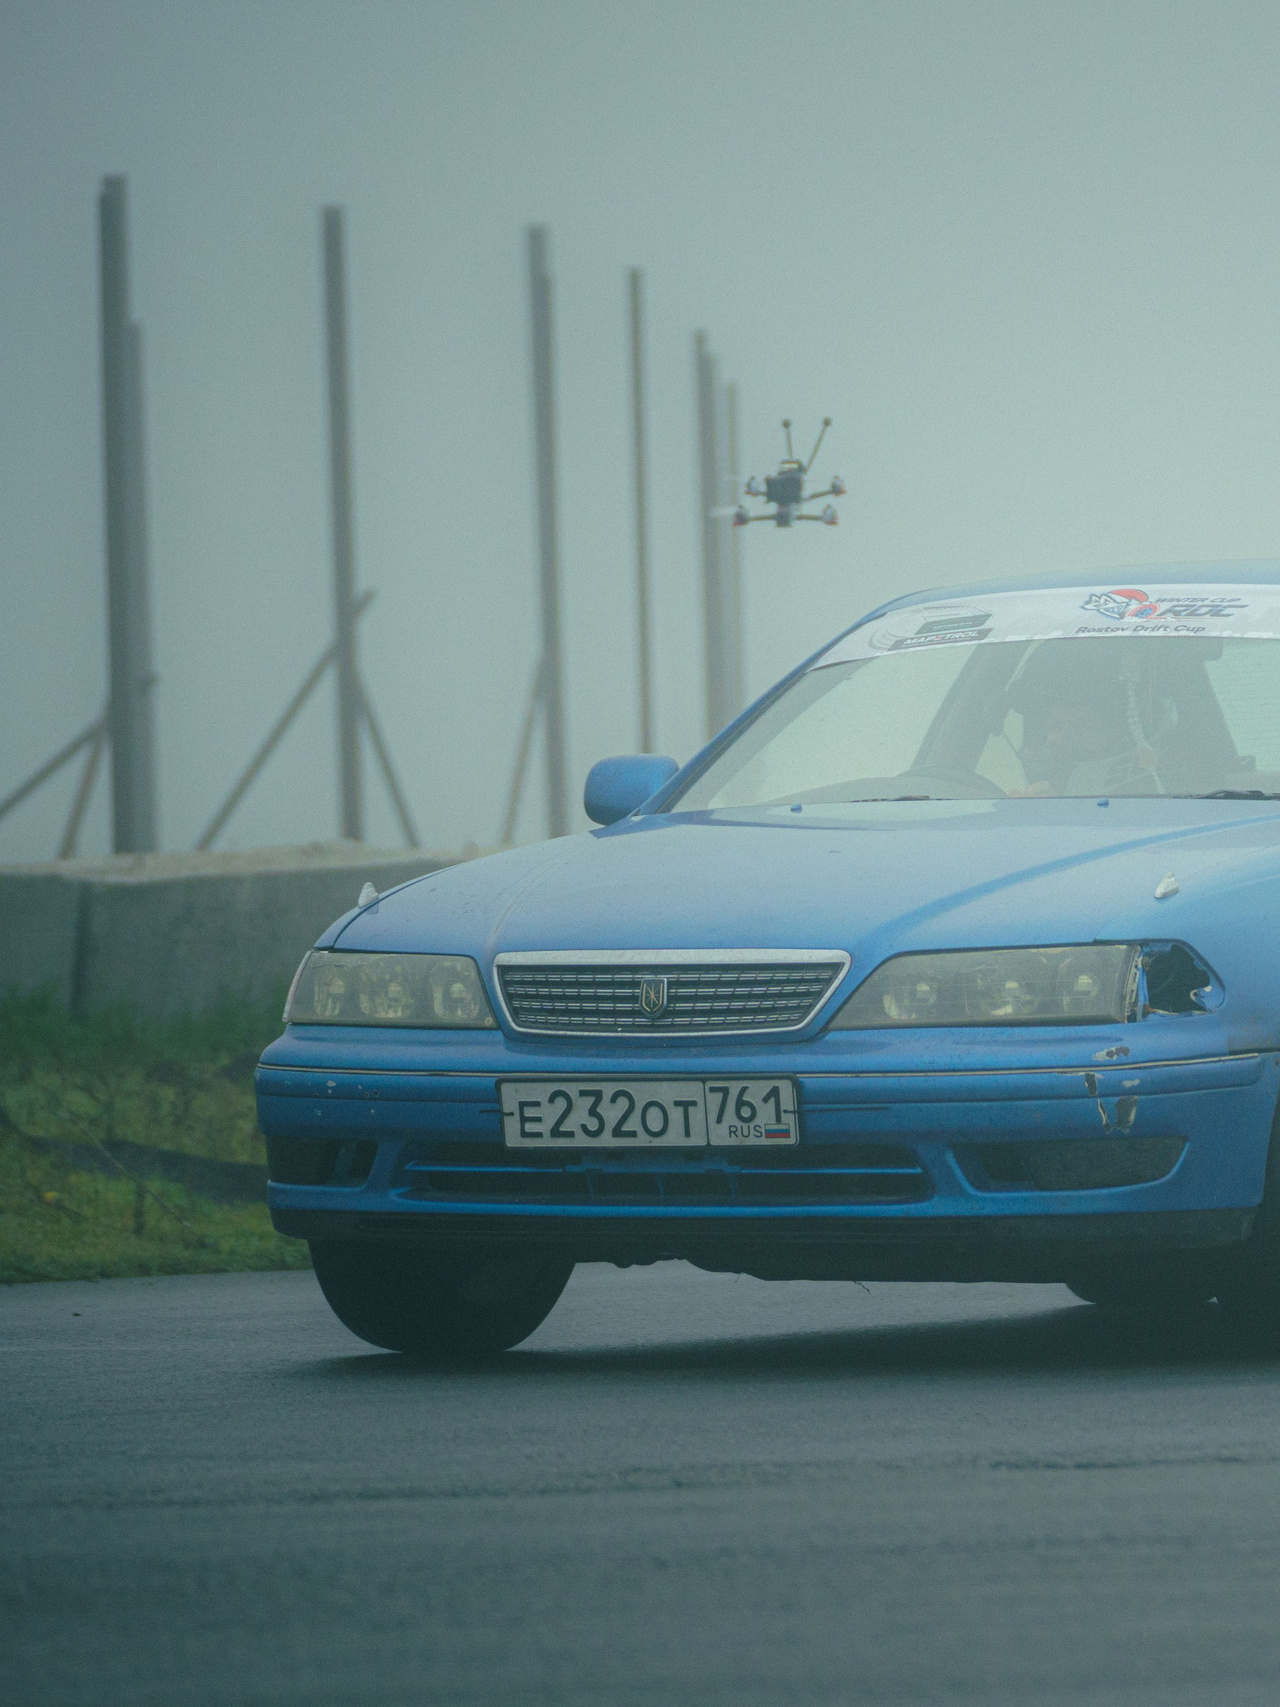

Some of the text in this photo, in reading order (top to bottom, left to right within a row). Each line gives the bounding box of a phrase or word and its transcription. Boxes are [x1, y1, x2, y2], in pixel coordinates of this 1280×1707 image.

[1156, 603, 1248, 618] RDC
[1075, 624, 1206, 634] Rostov Drift Cup
[708, 1085, 783, 1124] 761
[728, 1124, 763, 1139] RUS
